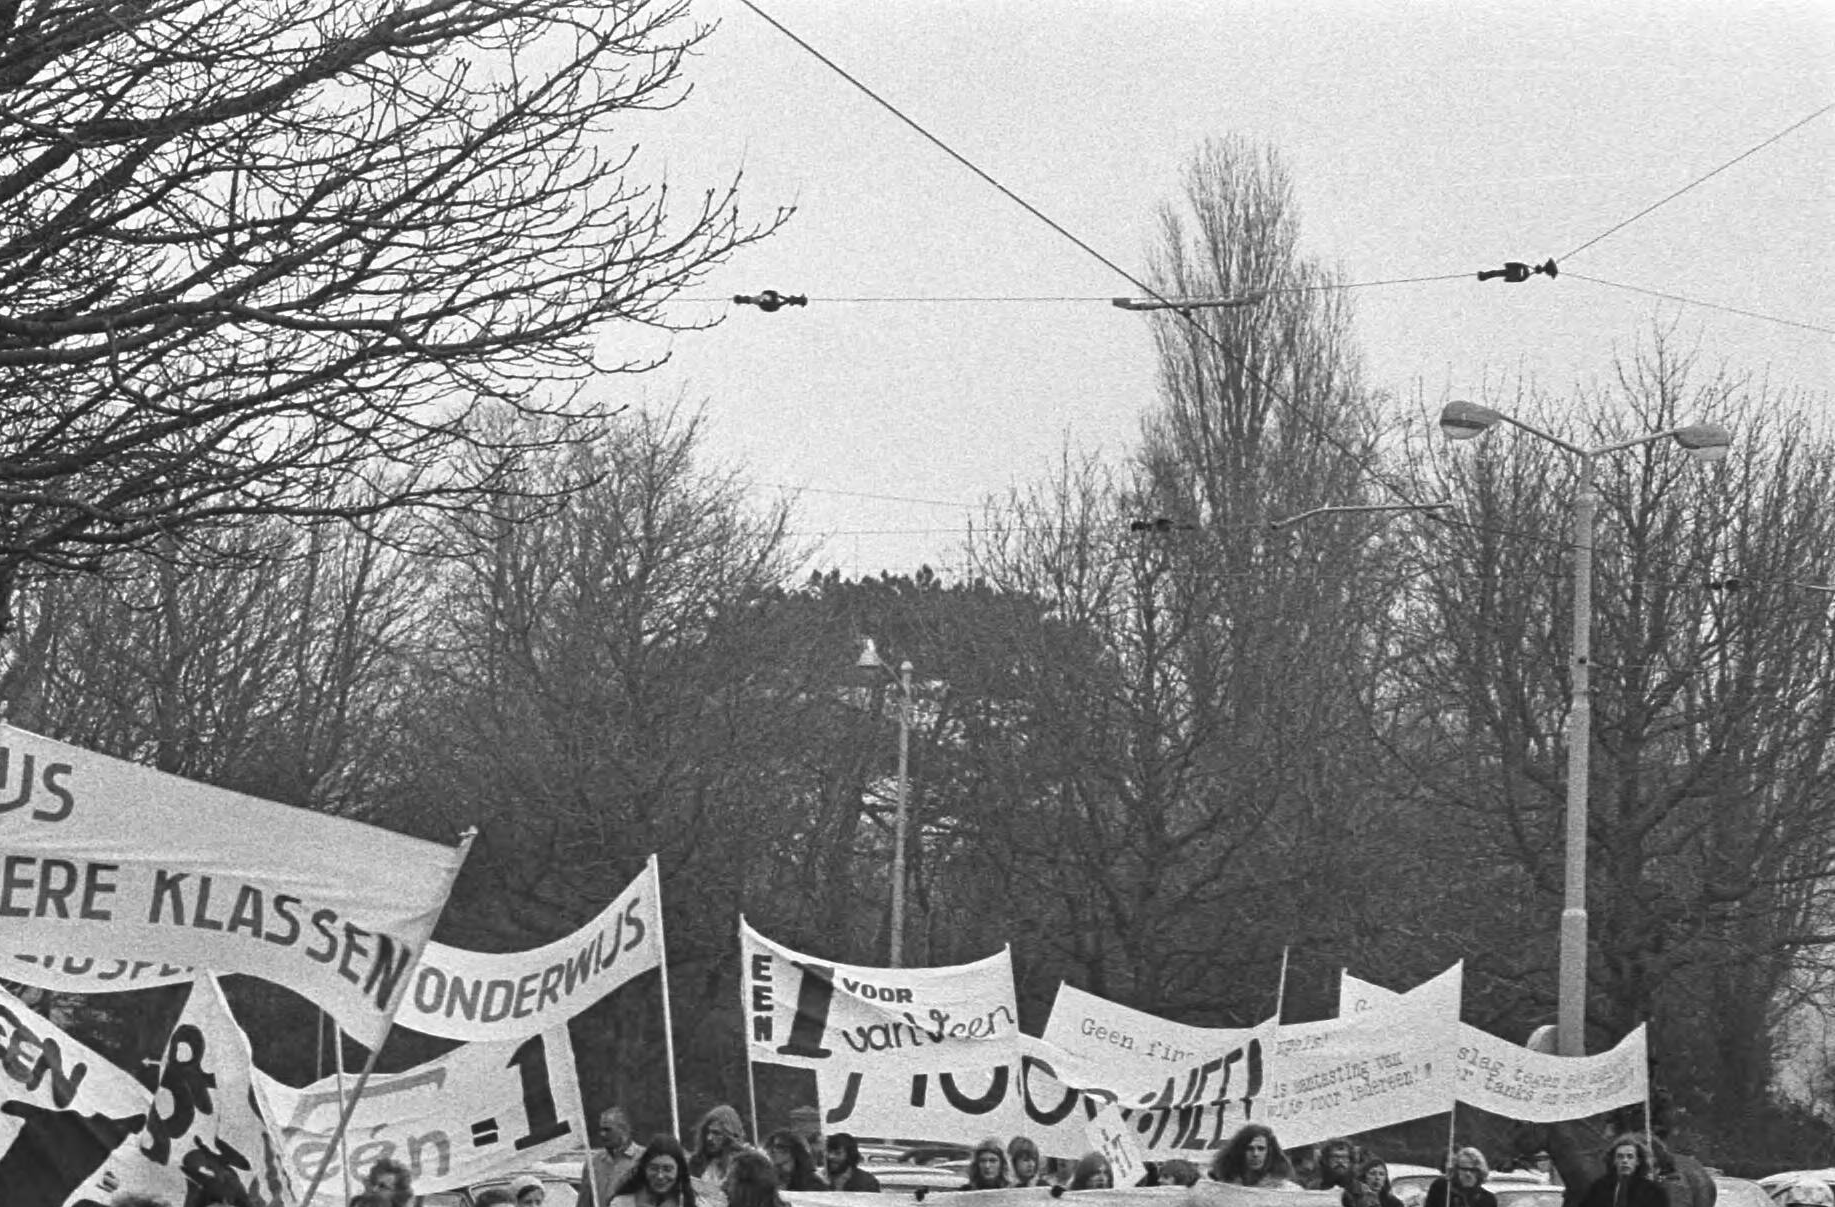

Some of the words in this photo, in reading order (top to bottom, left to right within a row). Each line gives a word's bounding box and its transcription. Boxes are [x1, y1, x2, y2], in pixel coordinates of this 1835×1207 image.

[148, 869, 412, 1011] KLASSEN
[414, 896, 646, 1023] ONDERWIJS
[751, 953, 773, 1042] EEN
[841, 976, 914, 1004] VOOR
[1080, 1017, 1135, 1051] Geen
